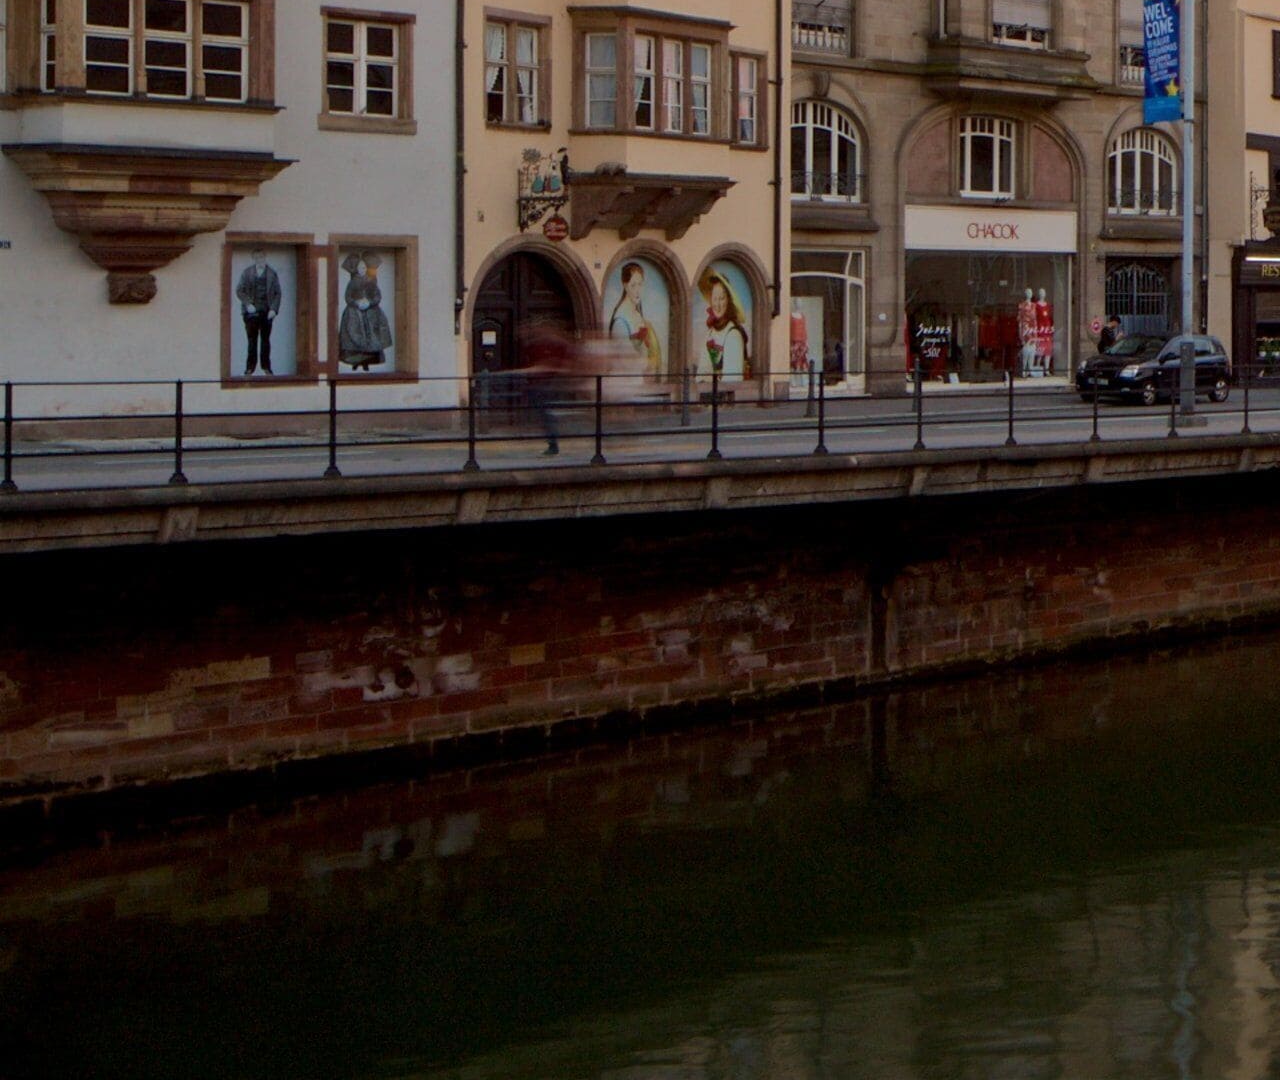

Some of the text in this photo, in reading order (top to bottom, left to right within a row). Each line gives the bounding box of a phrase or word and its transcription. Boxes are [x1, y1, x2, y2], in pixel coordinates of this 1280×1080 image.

[1144, 2, 1170, 21] WEL-
[1145, 17, 1174, 38] COME
[967, 222, 1020, 240] CHACOK
